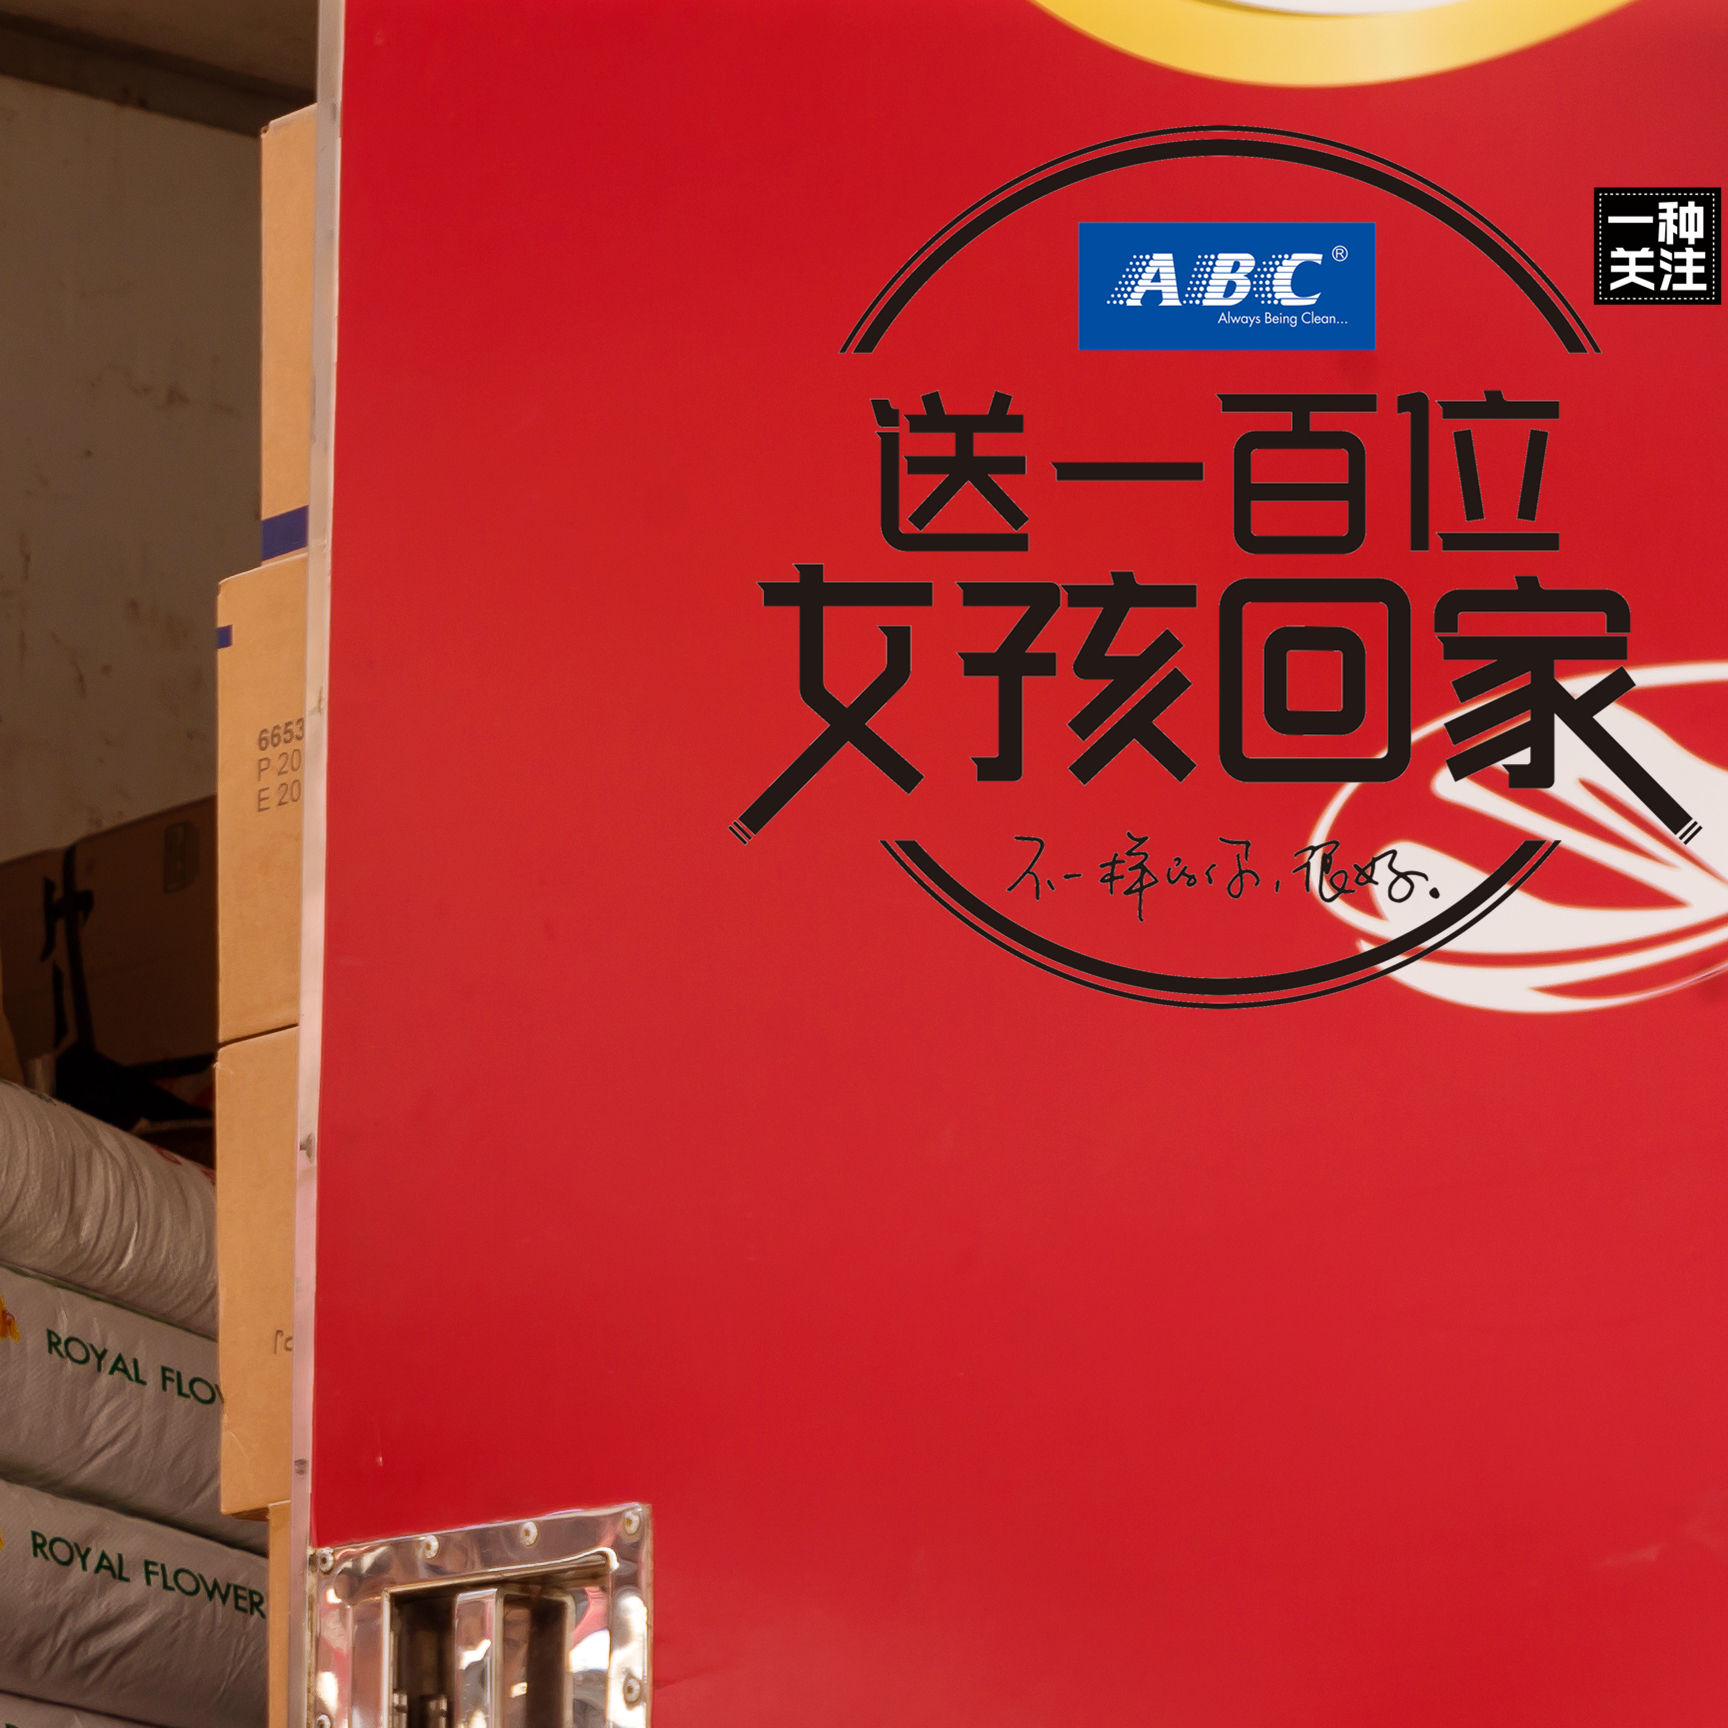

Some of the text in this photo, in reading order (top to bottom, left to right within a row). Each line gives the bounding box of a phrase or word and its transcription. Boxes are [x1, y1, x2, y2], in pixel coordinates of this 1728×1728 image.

[257, 757, 271, 782] P
[257, 786, 271, 813] E
[46, 1328, 147, 1386] ROYAL
[30, 1530, 266, 1619] ROYAL FLOWER
